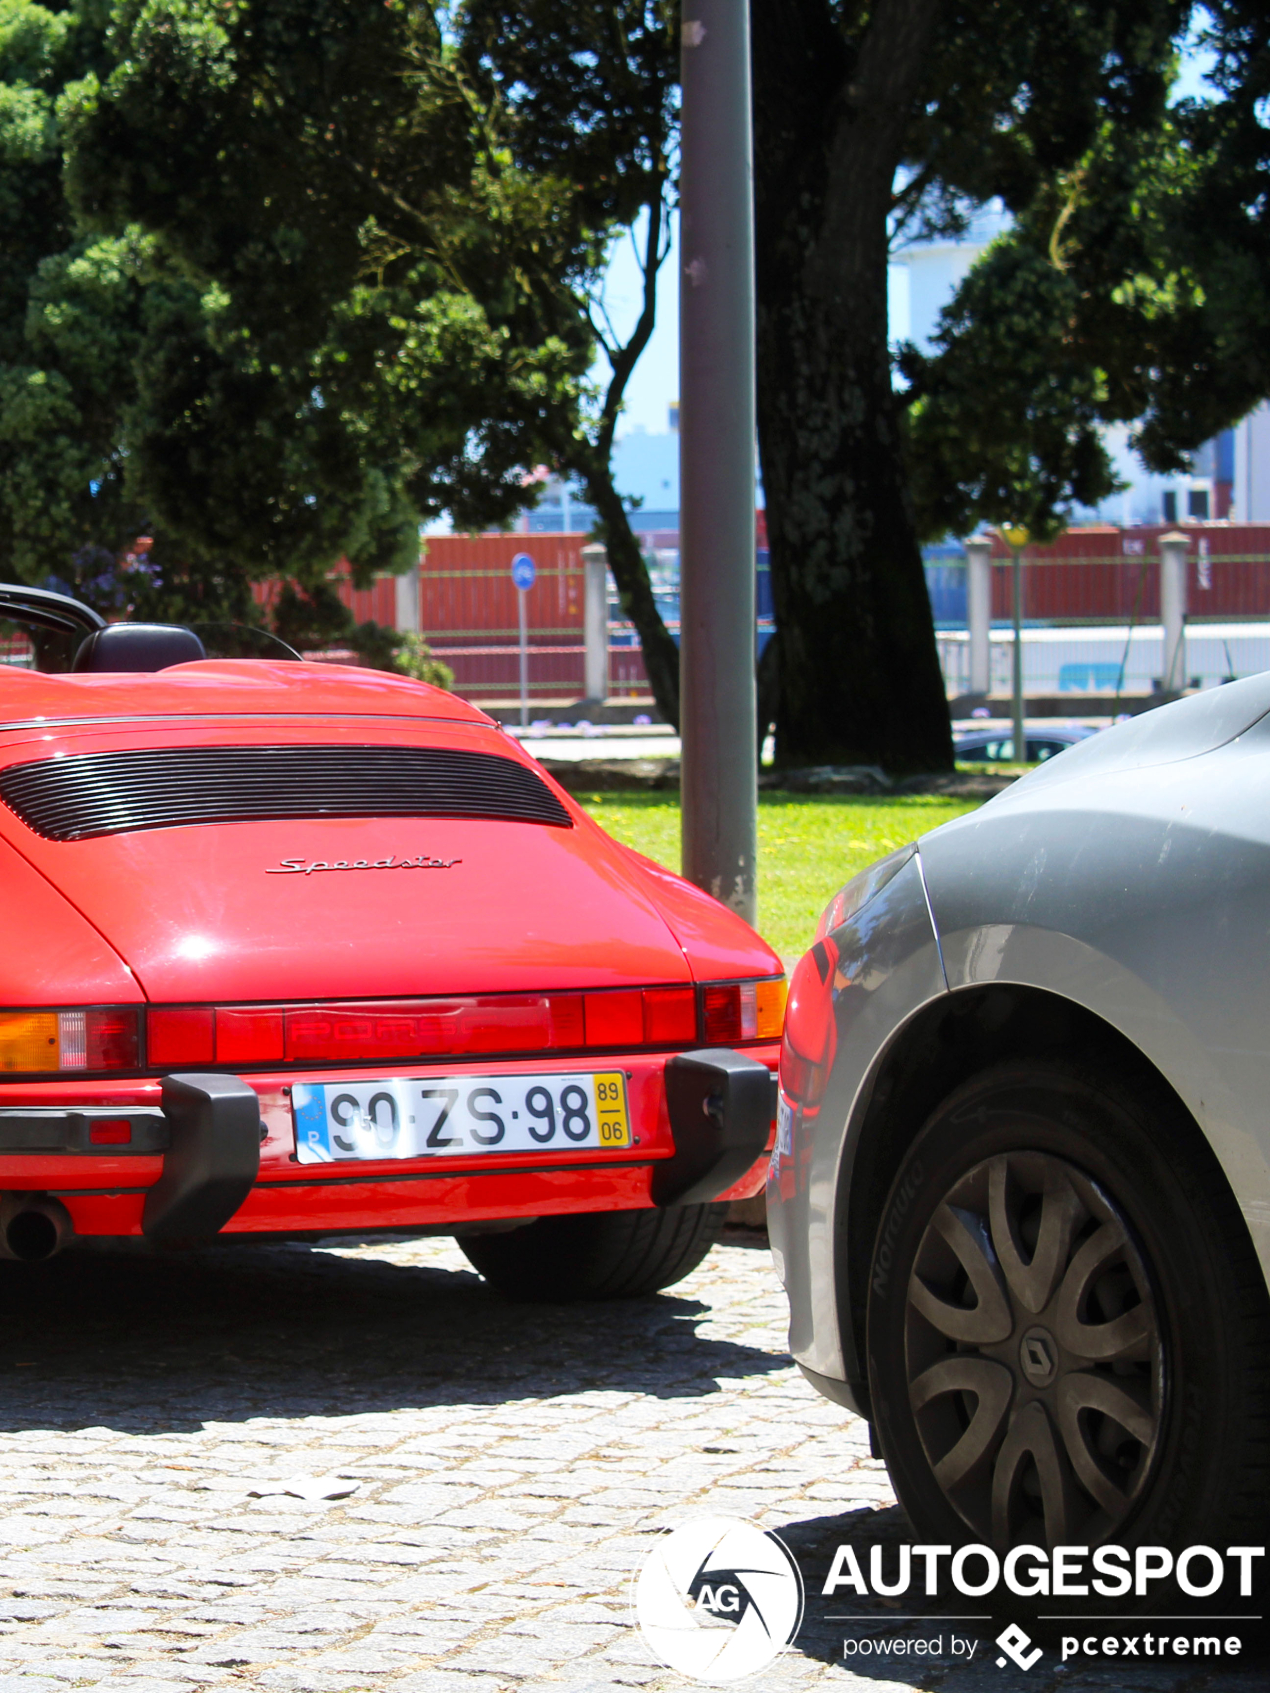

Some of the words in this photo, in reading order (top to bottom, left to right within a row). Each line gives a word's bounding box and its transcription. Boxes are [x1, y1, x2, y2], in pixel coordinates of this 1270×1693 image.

[265, 854, 463, 875] Speedster
[290, 1012, 576, 1043] PORSCE
[597, 1082, 619, 1101] 89
[601, 1121, 623, 1141] 06
